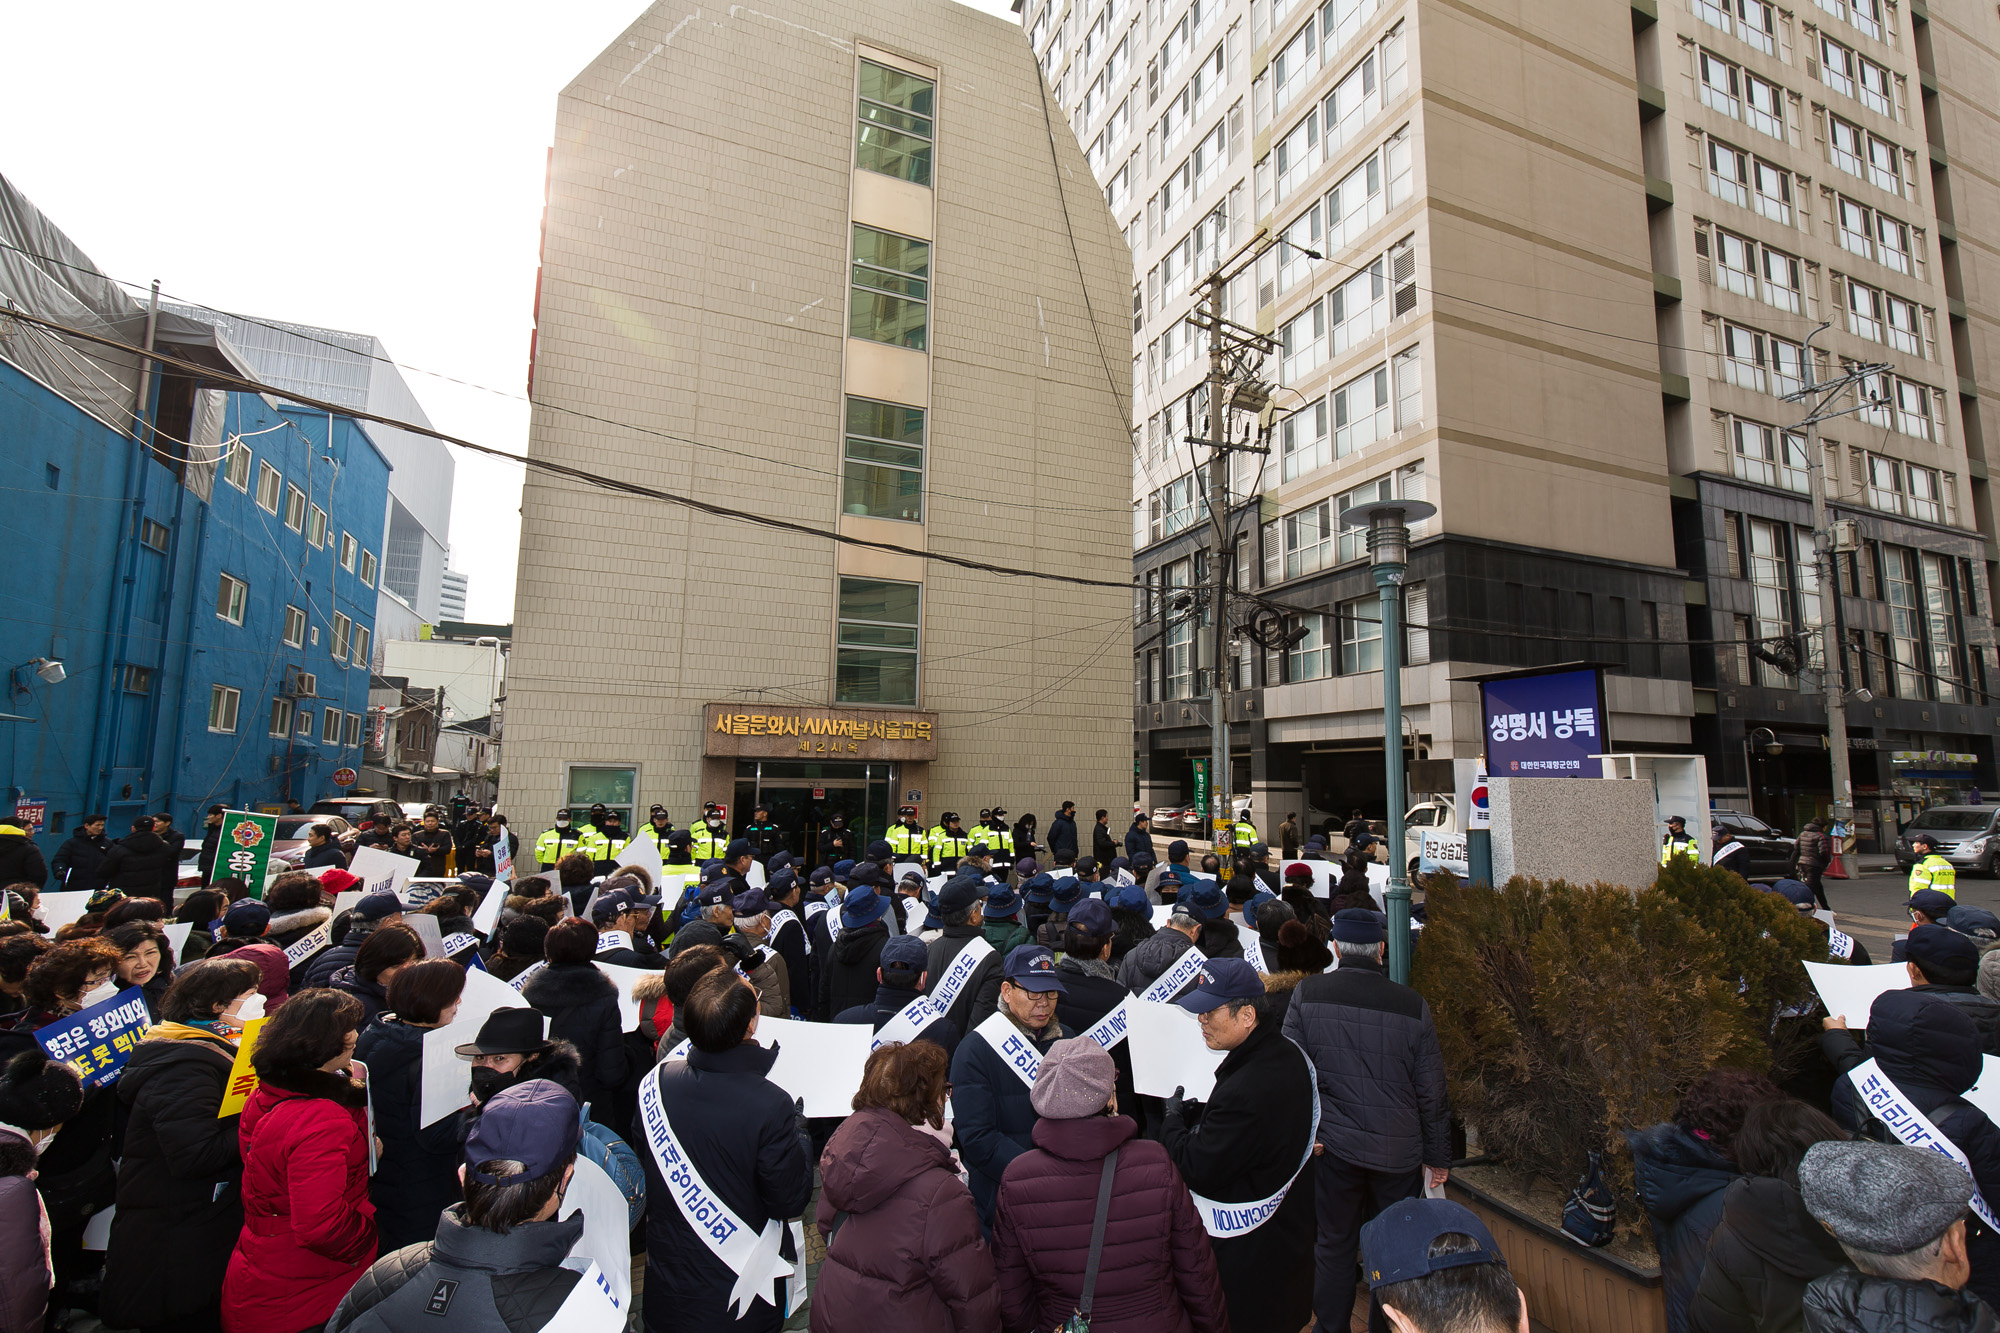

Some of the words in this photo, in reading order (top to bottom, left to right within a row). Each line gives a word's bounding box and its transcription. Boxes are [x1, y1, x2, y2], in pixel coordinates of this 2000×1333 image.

[1490, 711, 1547, 741] 성명서
[1552, 708, 1595, 738] 낭독
[1520, 760, 1580, 770] 대한민국재향군인회
[1425, 841, 1439, 859] 향군
[45, 1026, 90, 1060] 향군은
[88, 997, 147, 1039] 청와대와
[92, 1043, 114, 1068] 못
[642, 1069, 738, 1245] 대한민국재향군인회
[1212, 1186, 1290, 1231] ASSOCIATION
[432, 1302, 442, 1310] K2
